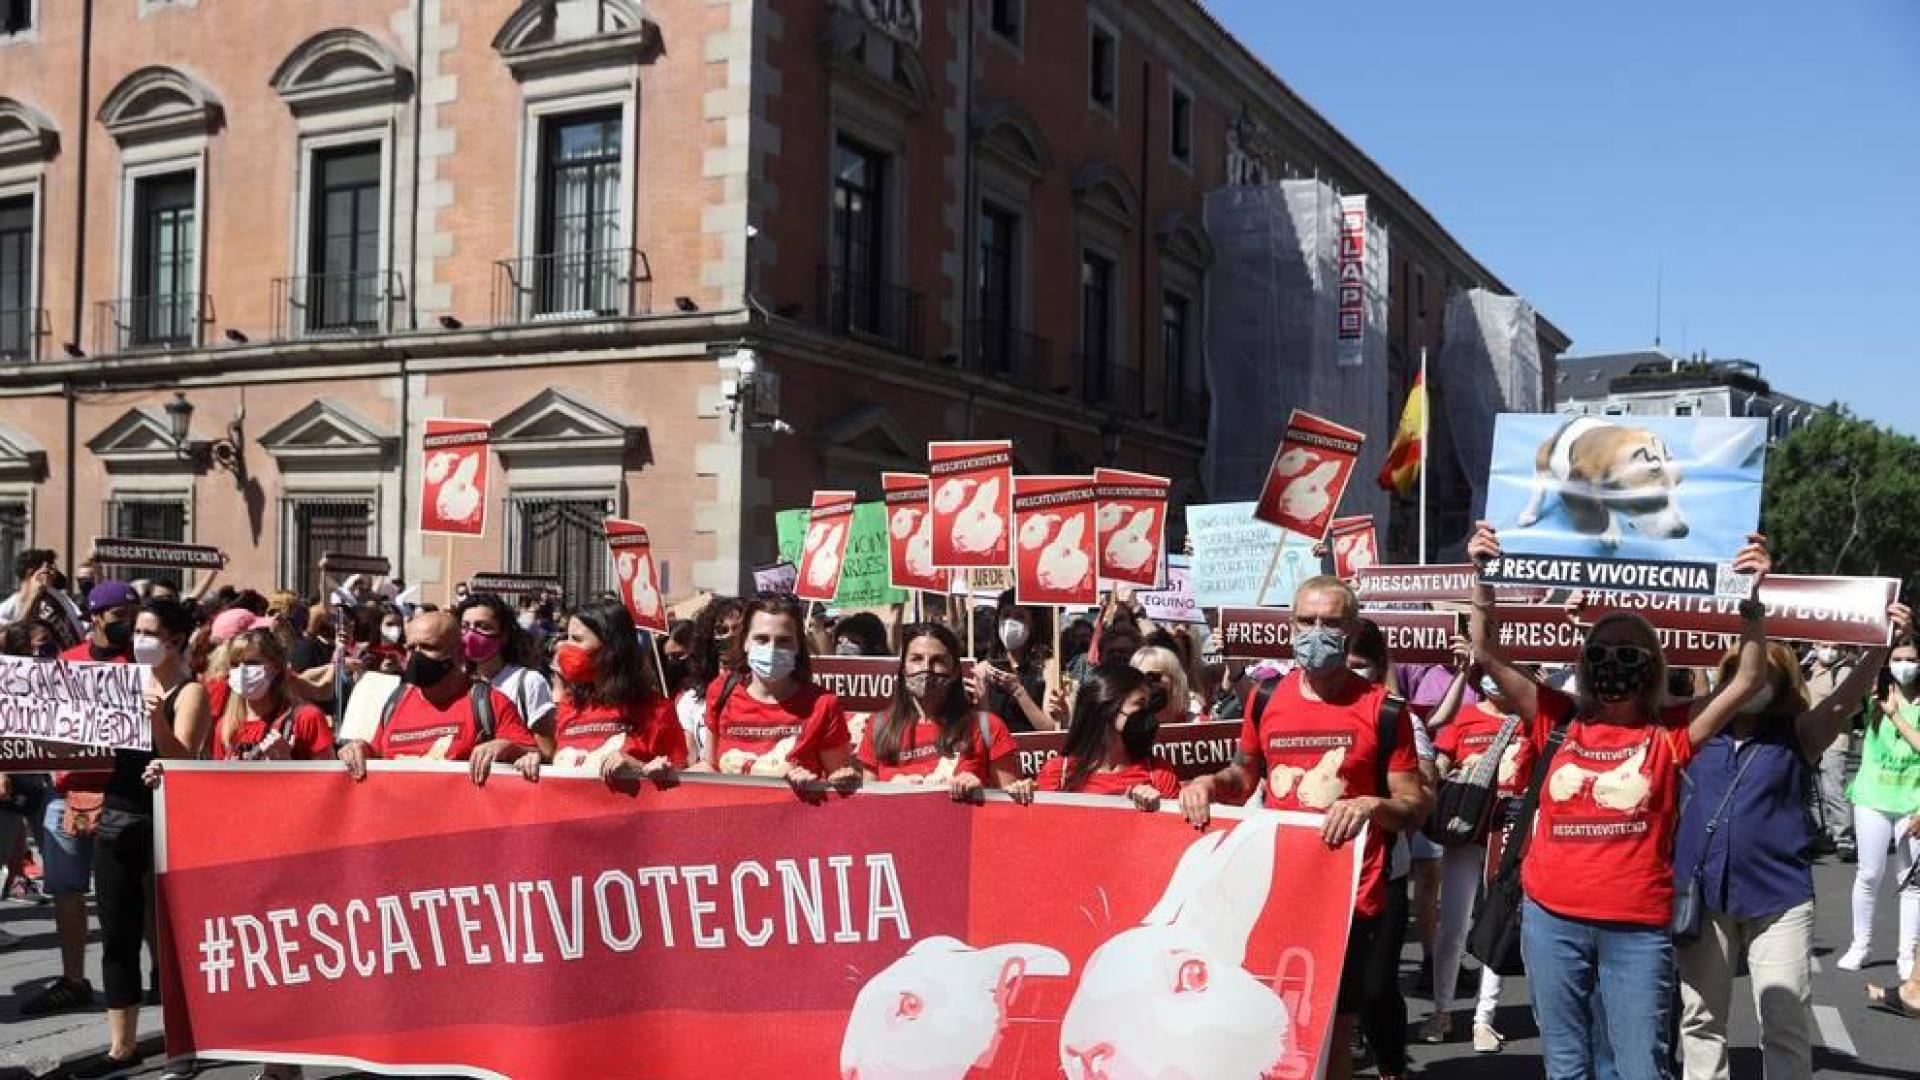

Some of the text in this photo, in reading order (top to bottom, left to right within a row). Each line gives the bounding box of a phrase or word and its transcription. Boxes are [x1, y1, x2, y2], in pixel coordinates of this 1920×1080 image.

[1503, 558, 1581, 581] RESCATE
[1587, 562, 1709, 590] VIVOTECNIA
[199, 852, 912, 993] #RESCATEVIVOTECNIA
